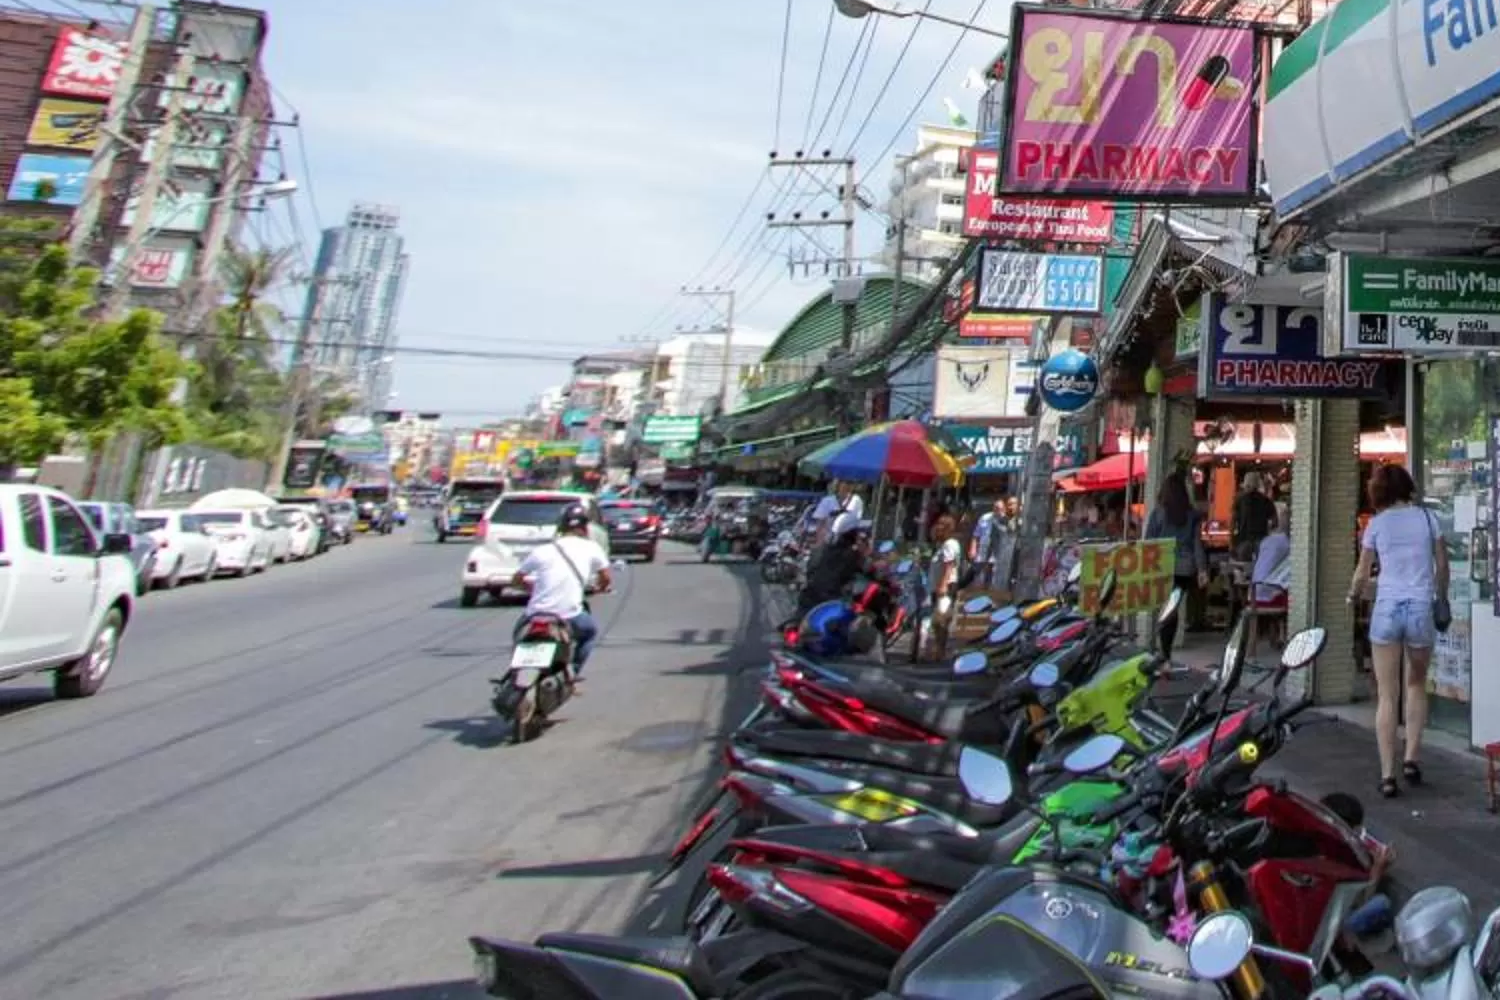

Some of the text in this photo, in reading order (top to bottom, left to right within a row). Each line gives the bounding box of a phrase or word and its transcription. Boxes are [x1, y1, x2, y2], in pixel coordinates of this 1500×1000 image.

[1024, 27, 1177, 128] ยา
[1015, 139, 1241, 186] PHARMACY
[991, 199, 1089, 221] Restaurant
[968, 217, 1031, 235] European
[1216, 359, 1380, 388] PHARMACY
[985, 456, 1026, 468] HOTE
[1093, 544, 1162, 578] FOR
[1083, 576, 1169, 612] RENT
